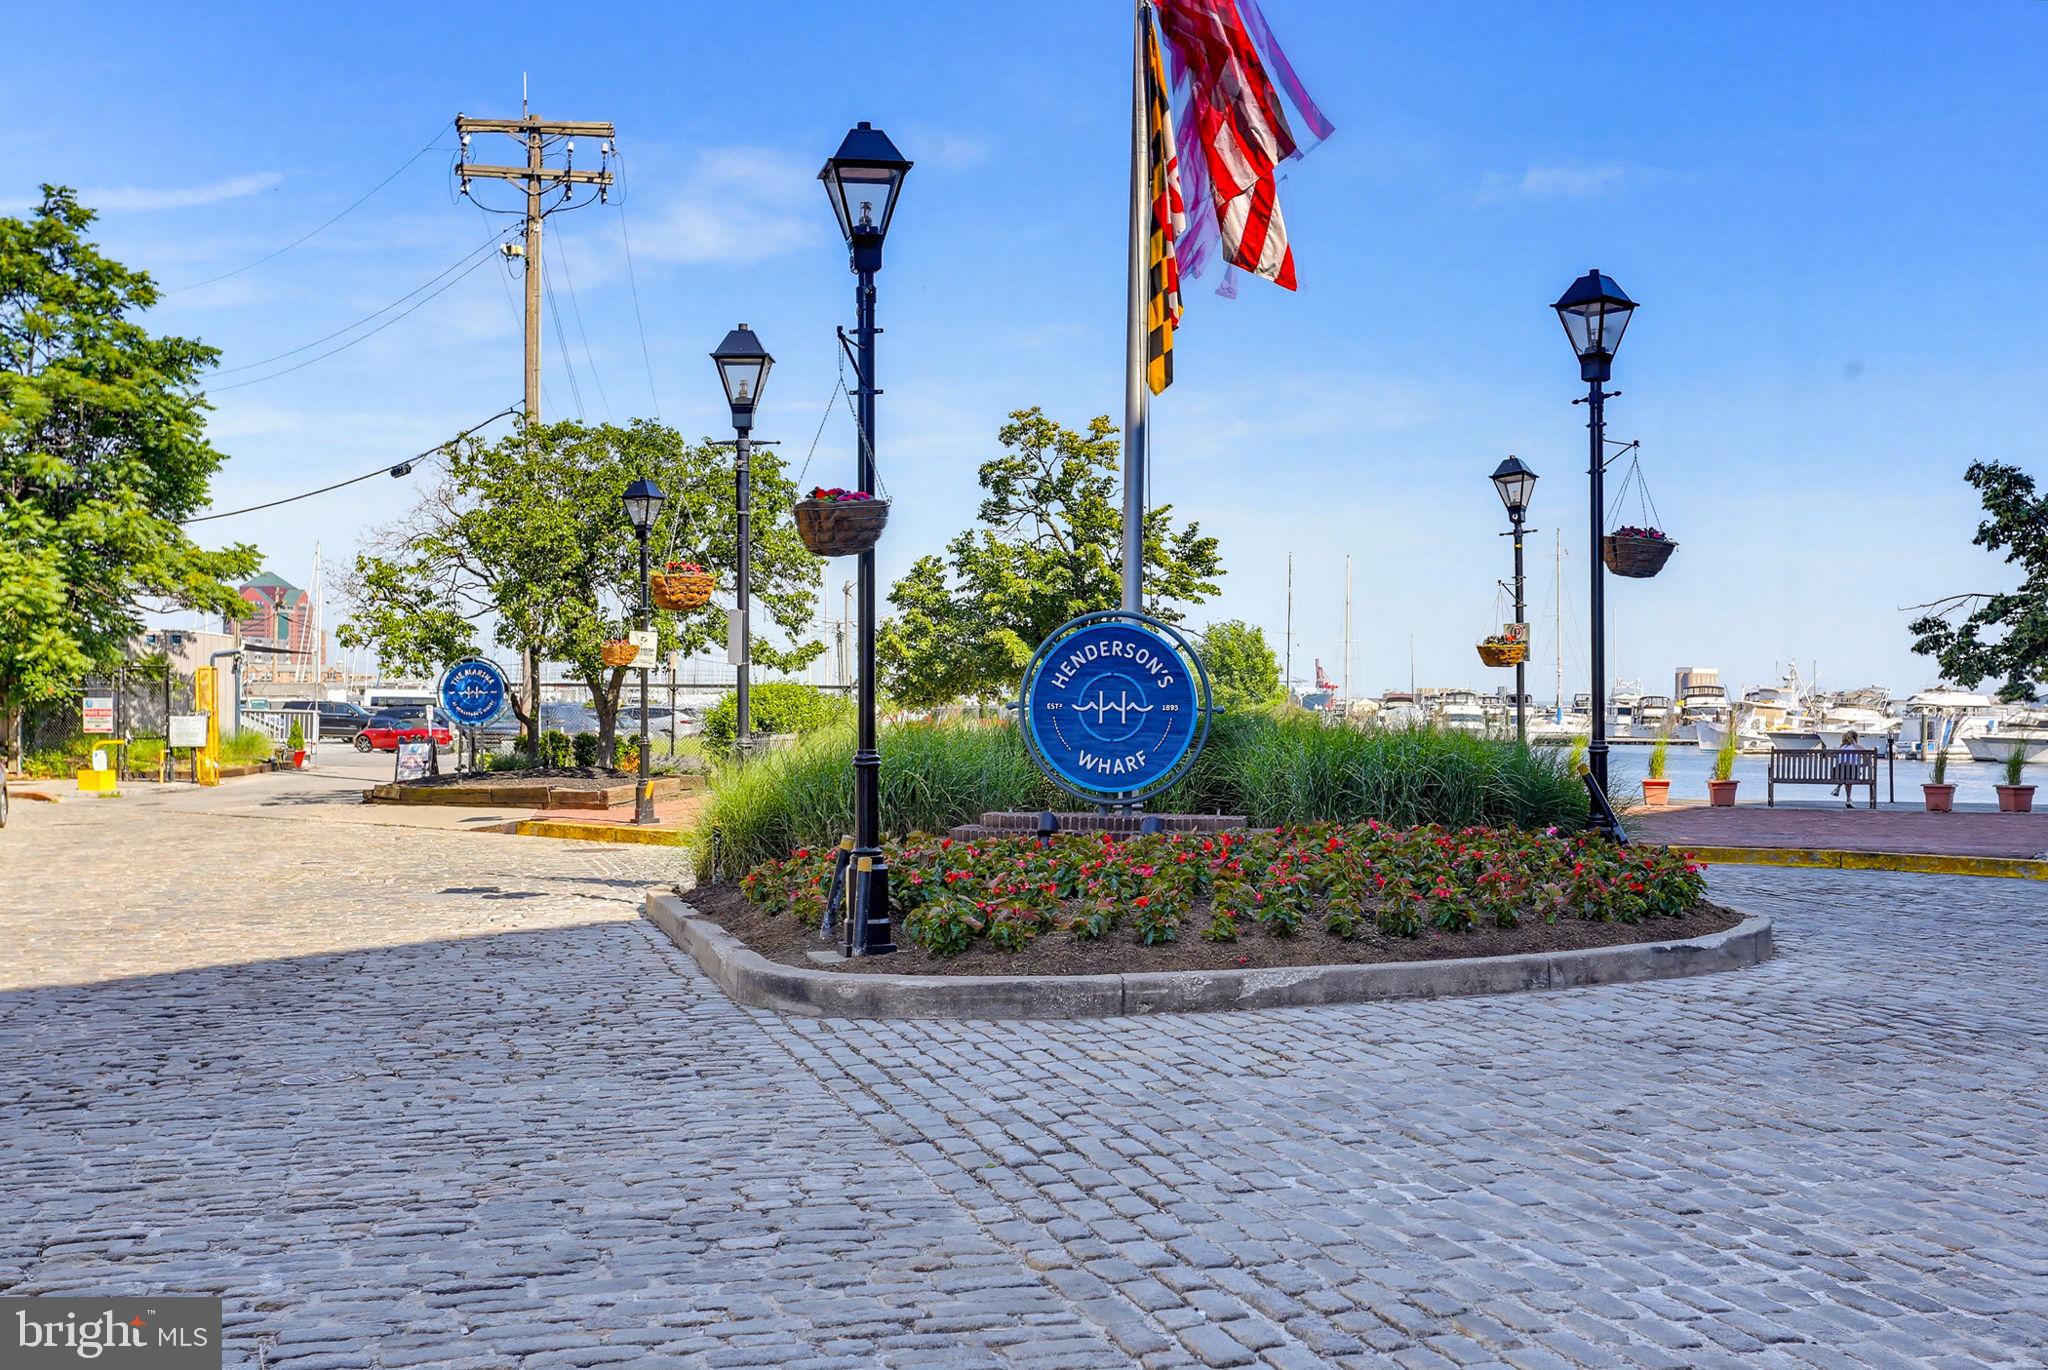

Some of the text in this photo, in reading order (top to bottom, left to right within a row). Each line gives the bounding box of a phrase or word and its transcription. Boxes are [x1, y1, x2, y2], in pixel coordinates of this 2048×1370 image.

[450, 668, 495, 685] THE MARINA
[1051, 641, 1174, 689] HENDERSON'S
[1078, 750, 1148, 775] WHARF
